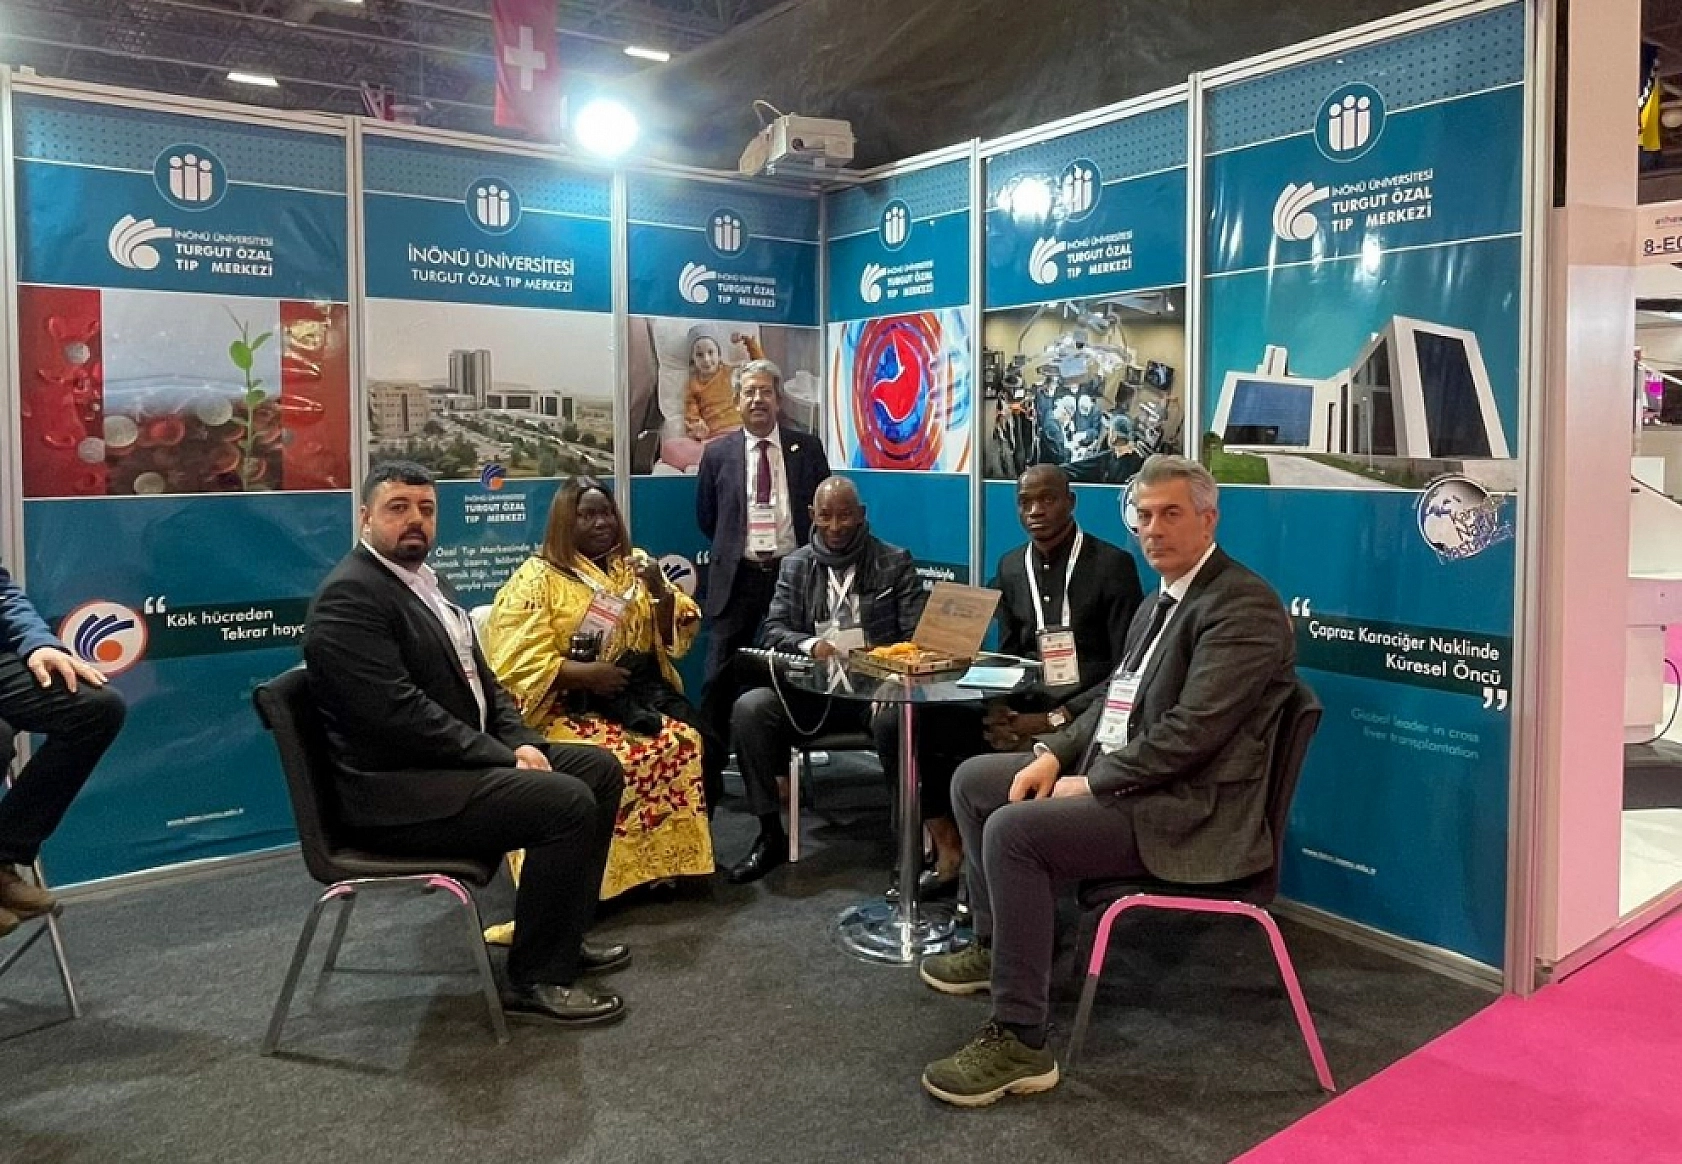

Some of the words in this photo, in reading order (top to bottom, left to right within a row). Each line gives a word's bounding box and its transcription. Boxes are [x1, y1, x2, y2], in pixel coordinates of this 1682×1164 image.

[1332, 180, 1366, 197] İNÖNÜ
[1367, 168, 1433, 191] ÜNİVERSİTESİ
[1332, 192, 1388, 214] TURGUT
[1391, 186, 1433, 205] ÖZAL
[1332, 218, 1354, 233] TIP
[1366, 202, 1432, 227] MERKEZİ
[175, 242, 233, 258] TURGUT
[235, 246, 273, 261] ÖZAL
[408, 243, 470, 266] İNÖNÜ
[474, 249, 574, 276] ÜNİVERSİTESİ
[1067, 248, 1103, 263] TURGUT
[1106, 243, 1132, 258] ÖZAL
[175, 258, 199, 271] TIP
[211, 261, 272, 277] MERKEZİ
[1067, 266, 1081, 278] TIP
[1088, 256, 1132, 275] MERKEZİ
[411, 268, 464, 284] TURGUT
[468, 271, 501, 287] ÖZAL
[504, 276, 522, 288] TIP
[524, 279, 573, 293] MERKEZİ
[465, 503, 499, 513] TURGUT
[502, 501, 526, 511] ÖZAL
[487, 512, 526, 523] MERKEZİ
[166, 612, 197, 629] Kök
[202, 606, 274, 624] hücreden
[221, 626, 269, 641] Tekrar
[273, 623, 306, 638] haya
[1309, 620, 1355, 639] Çapraz
[1358, 627, 1426, 652] Karaciğer
[1430, 635, 1500, 661] Naklinde
[1386, 652, 1447, 678] Küresel
[1453, 659, 1501, 685] Öncü
[1351, 707, 1391, 724] Global
[1393, 715, 1430, 733] leader
[1433, 722, 1445, 736] in
[1449, 729, 1480, 743] cross
[1390, 732, 1479, 760] transplantation
